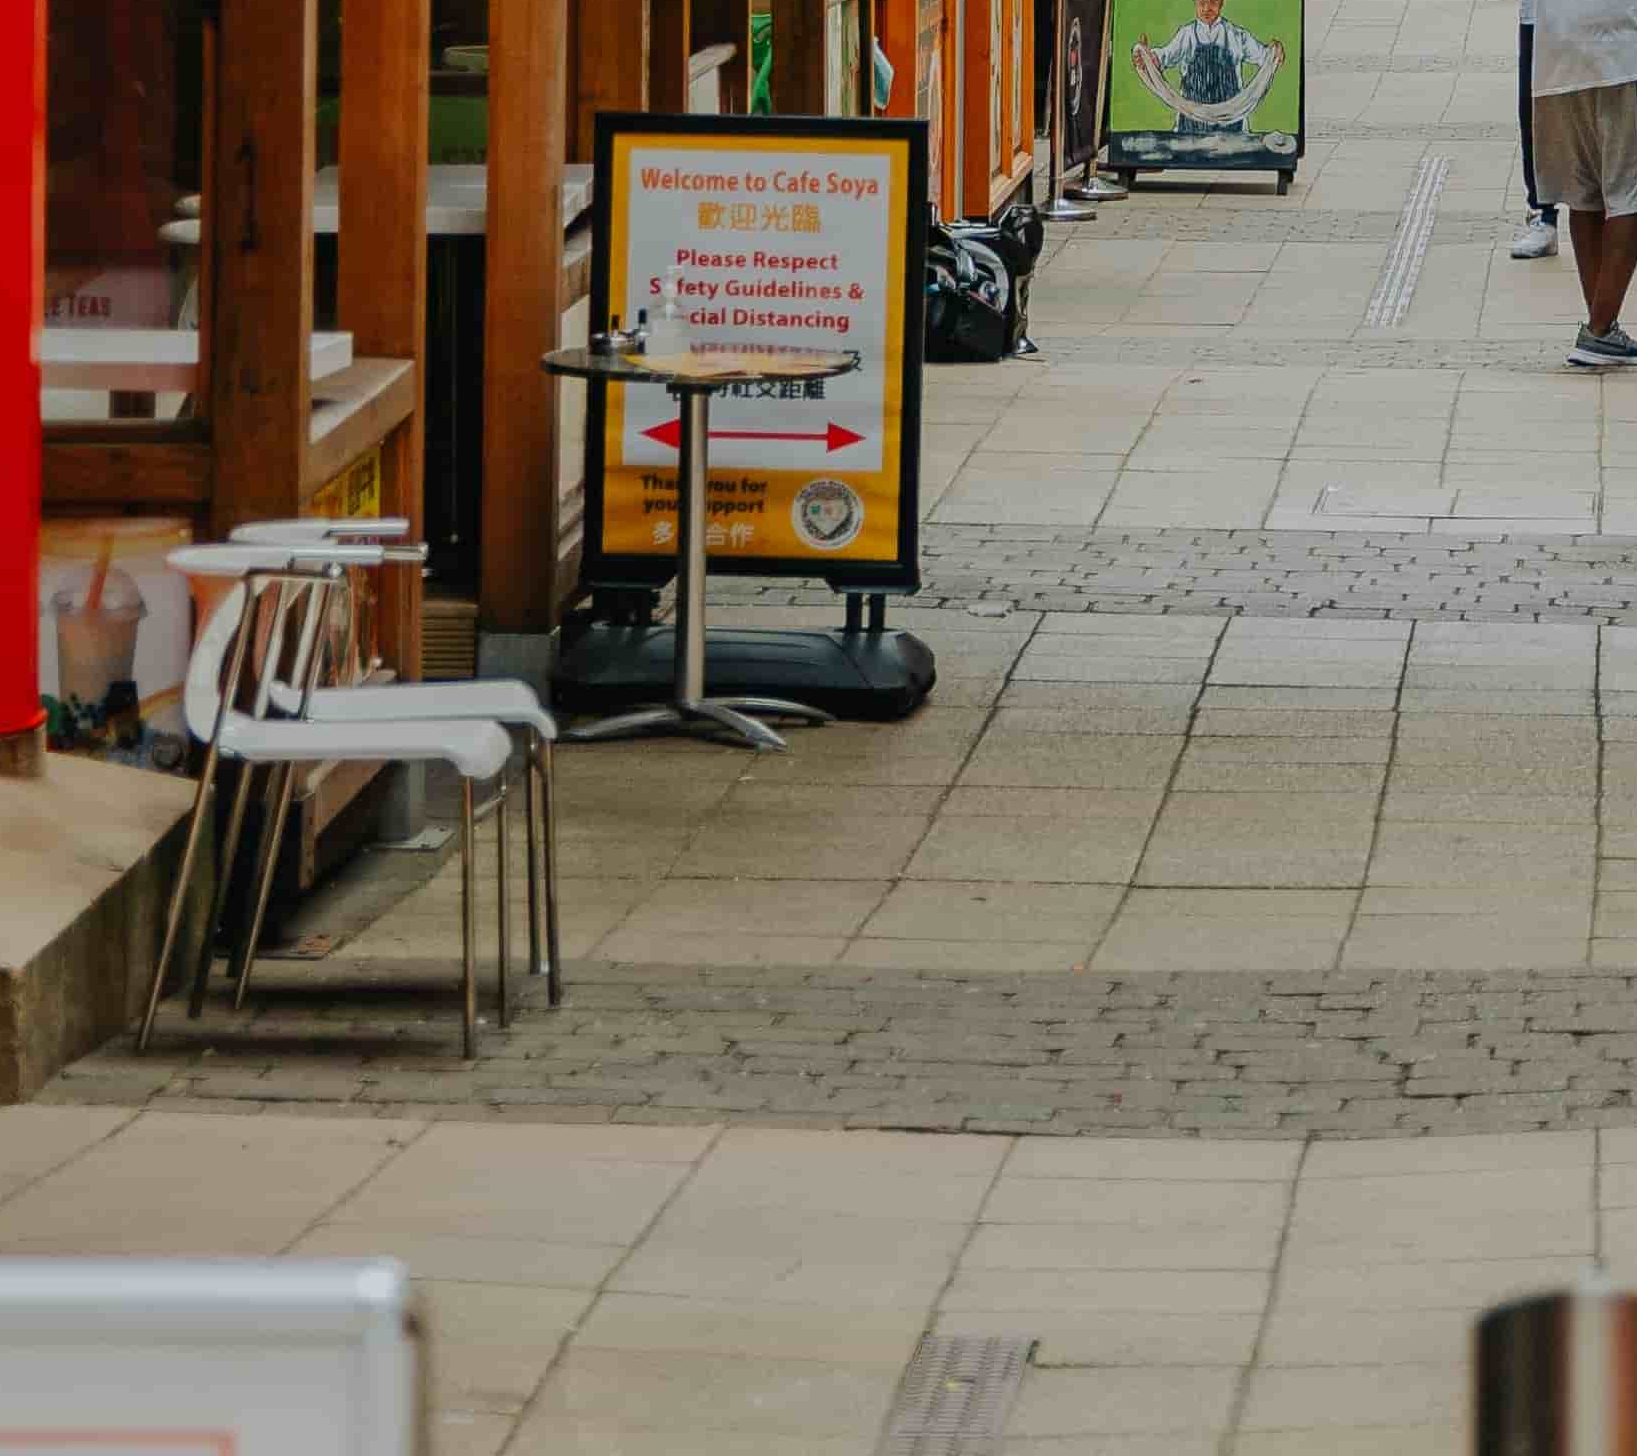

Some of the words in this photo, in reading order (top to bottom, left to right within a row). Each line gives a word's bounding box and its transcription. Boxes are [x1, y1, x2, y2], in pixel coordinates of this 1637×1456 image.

[640, 167, 739, 191] Welcome
[744, 172, 767, 192] to
[772, 170, 821, 194] Cafe
[826, 172, 879, 201] Soya
[697, 200, 822, 233] 歡迎光臨
[676, 248, 747, 268] Please
[753, 250, 839, 273] Respect
[649, 276, 720, 301] Sfety
[724, 279, 843, 300] Guidelines
[847, 283, 865, 300] &
[732, 308, 850, 333] Distancing
[643, 498, 680, 514] you
[652, 520, 756, 548] 多合作
